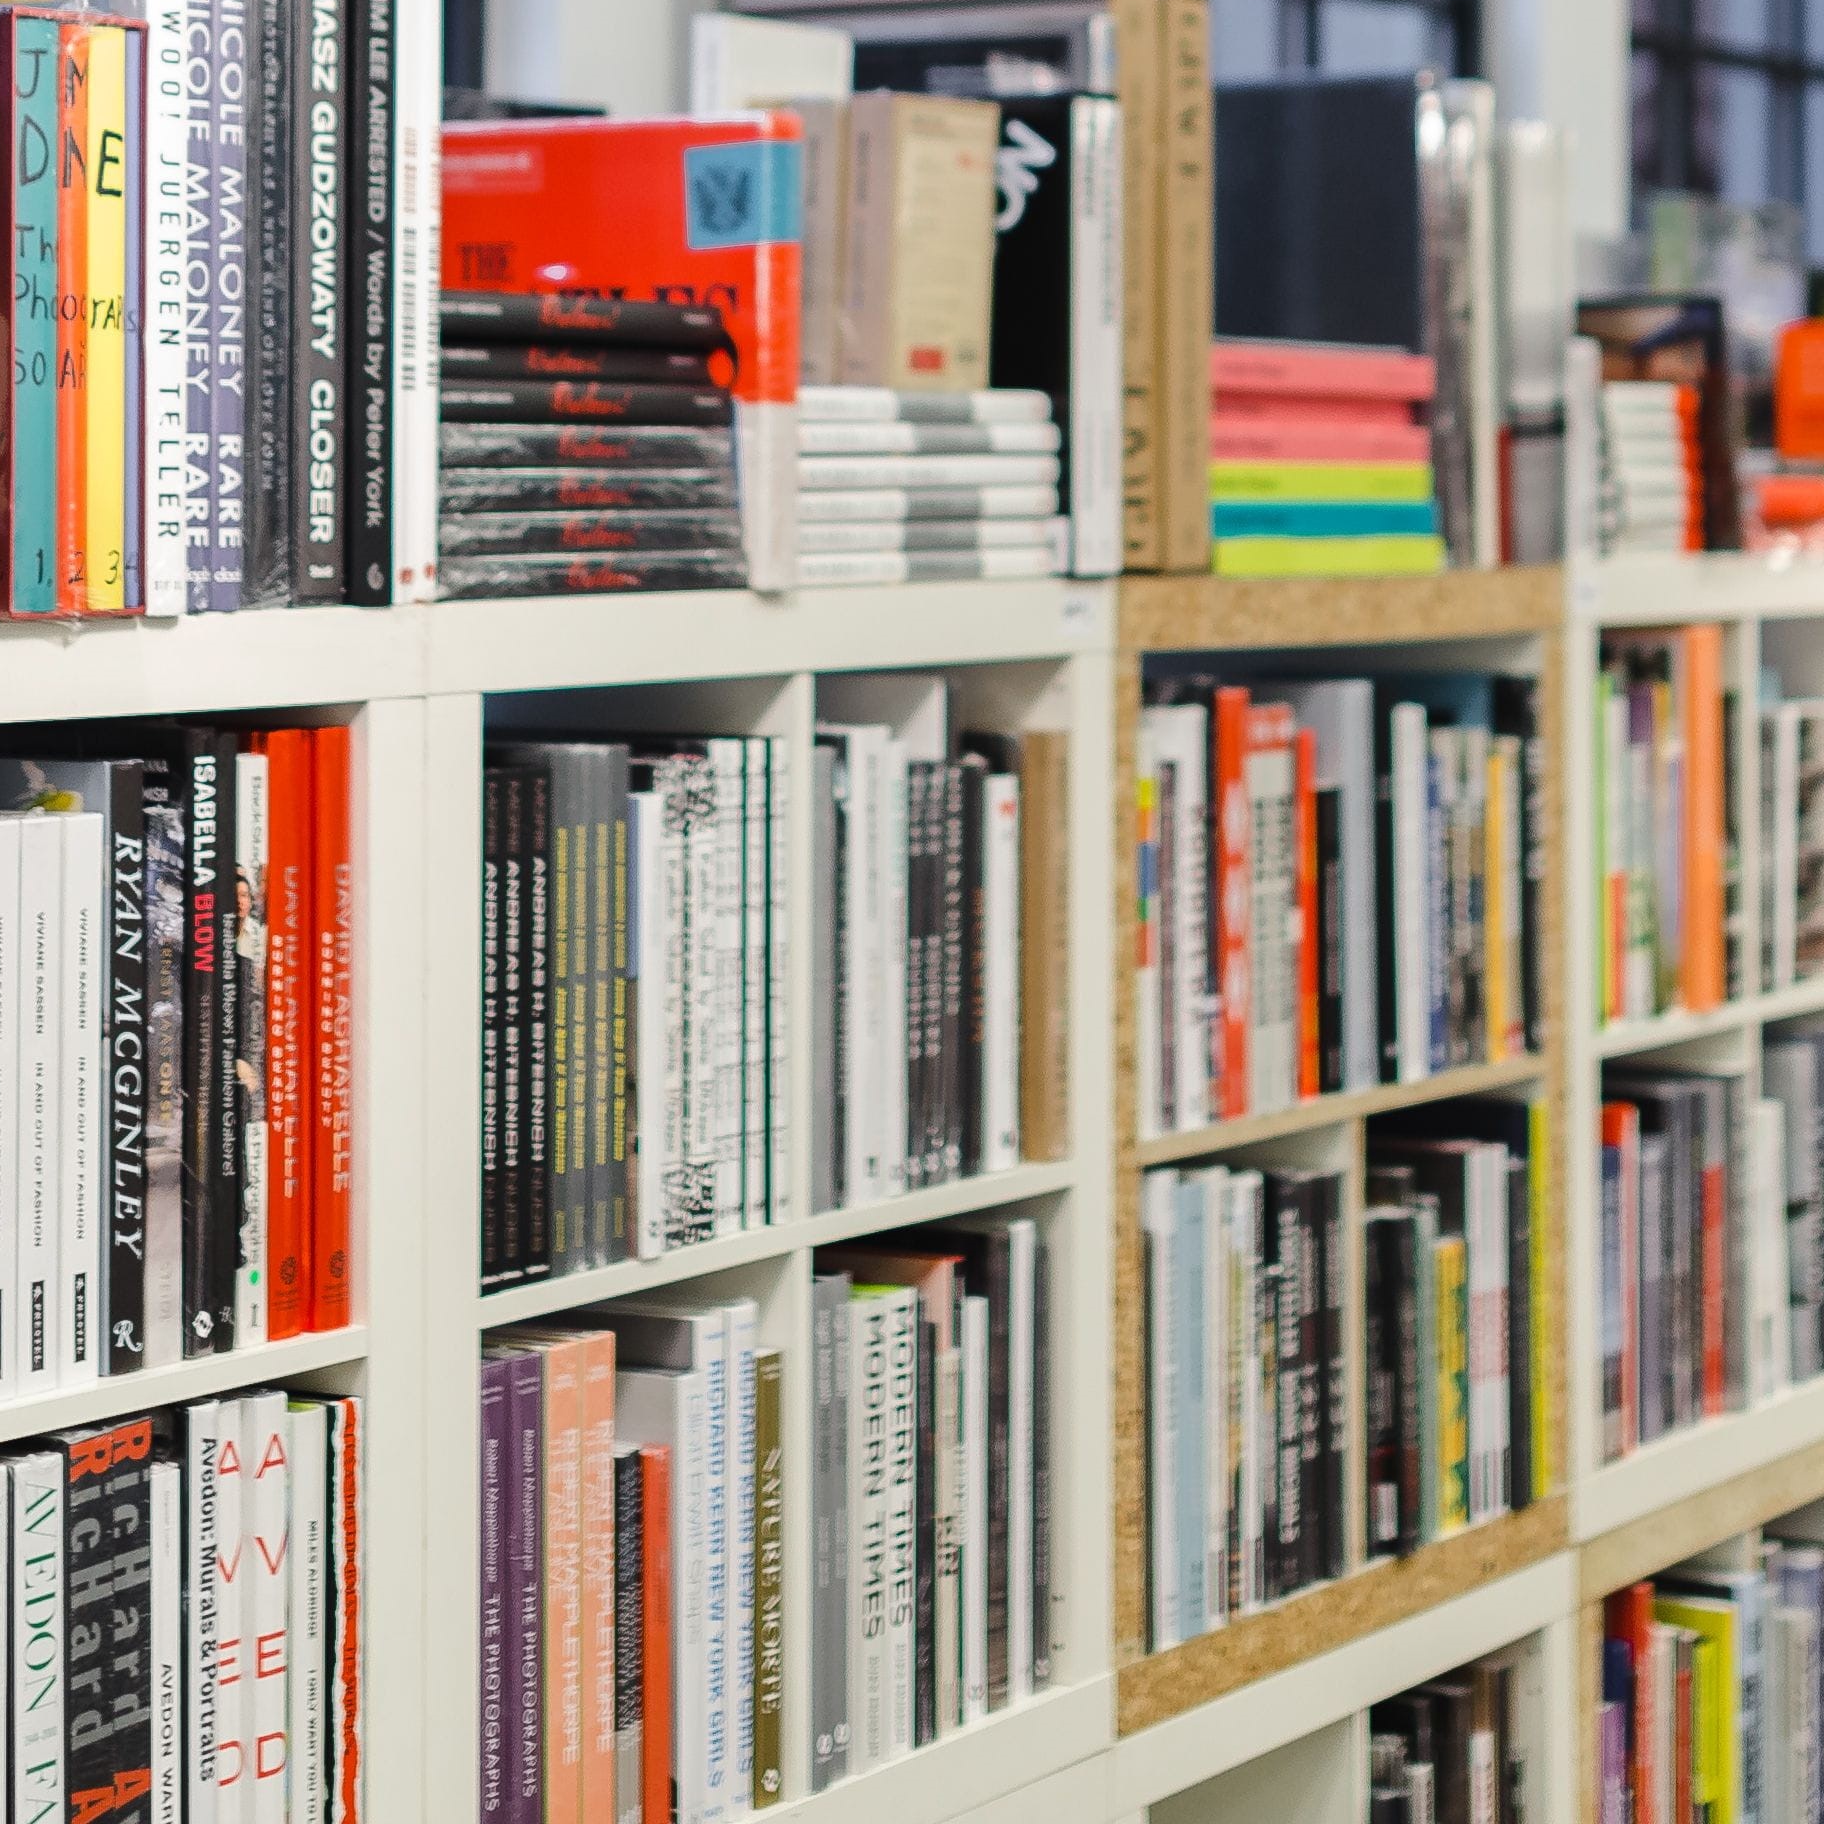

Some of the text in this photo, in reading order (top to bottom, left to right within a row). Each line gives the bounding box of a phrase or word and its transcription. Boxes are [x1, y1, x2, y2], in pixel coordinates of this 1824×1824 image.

[310, 101, 337, 359] GUDZOWATY
[368, 84, 387, 222] ARRESTED
[159, 11, 181, 538] WOO! JUERGEN TELLER
[217, 166, 243, 396] MALONEY
[367, 248, 385, 337] Words
[364, 343, 384, 380] by
[185, 433, 210, 548] RARE
[217, 433, 243, 548] RARE
[308, 379, 336, 543] CLOSER
[366, 466, 384, 527] York
[193, 756, 217, 886] ISABELLA
[35, 912, 45, 970] VIVIANE
[78, 909, 88, 966] VIVIANE
[193, 893, 215, 971] BLOW
[222, 913, 236, 1107] Isabella Fashion
[113, 833, 142, 1260] RYAN MCGINLEY
[34, 1083, 44, 1247] AND FASHION
[76, 1077, 87, 1240] AND FASHION
[485, 1439, 499, 1483] Robert
[862, 1315, 887, 1639] MODERN TIMES
[889, 1304, 915, 1628] MODERN TIMES
[25, 1481, 58, 1712] AVEDON
[199, 1437, 219, 1782] Avedon: Murals & Portraits
[160, 1663, 173, 1757] AVEDON
[483, 1592, 500, 1812] THE PHOTOGRAPHS
[521, 1582, 537, 1797] THE PHOTOGRAPHS
